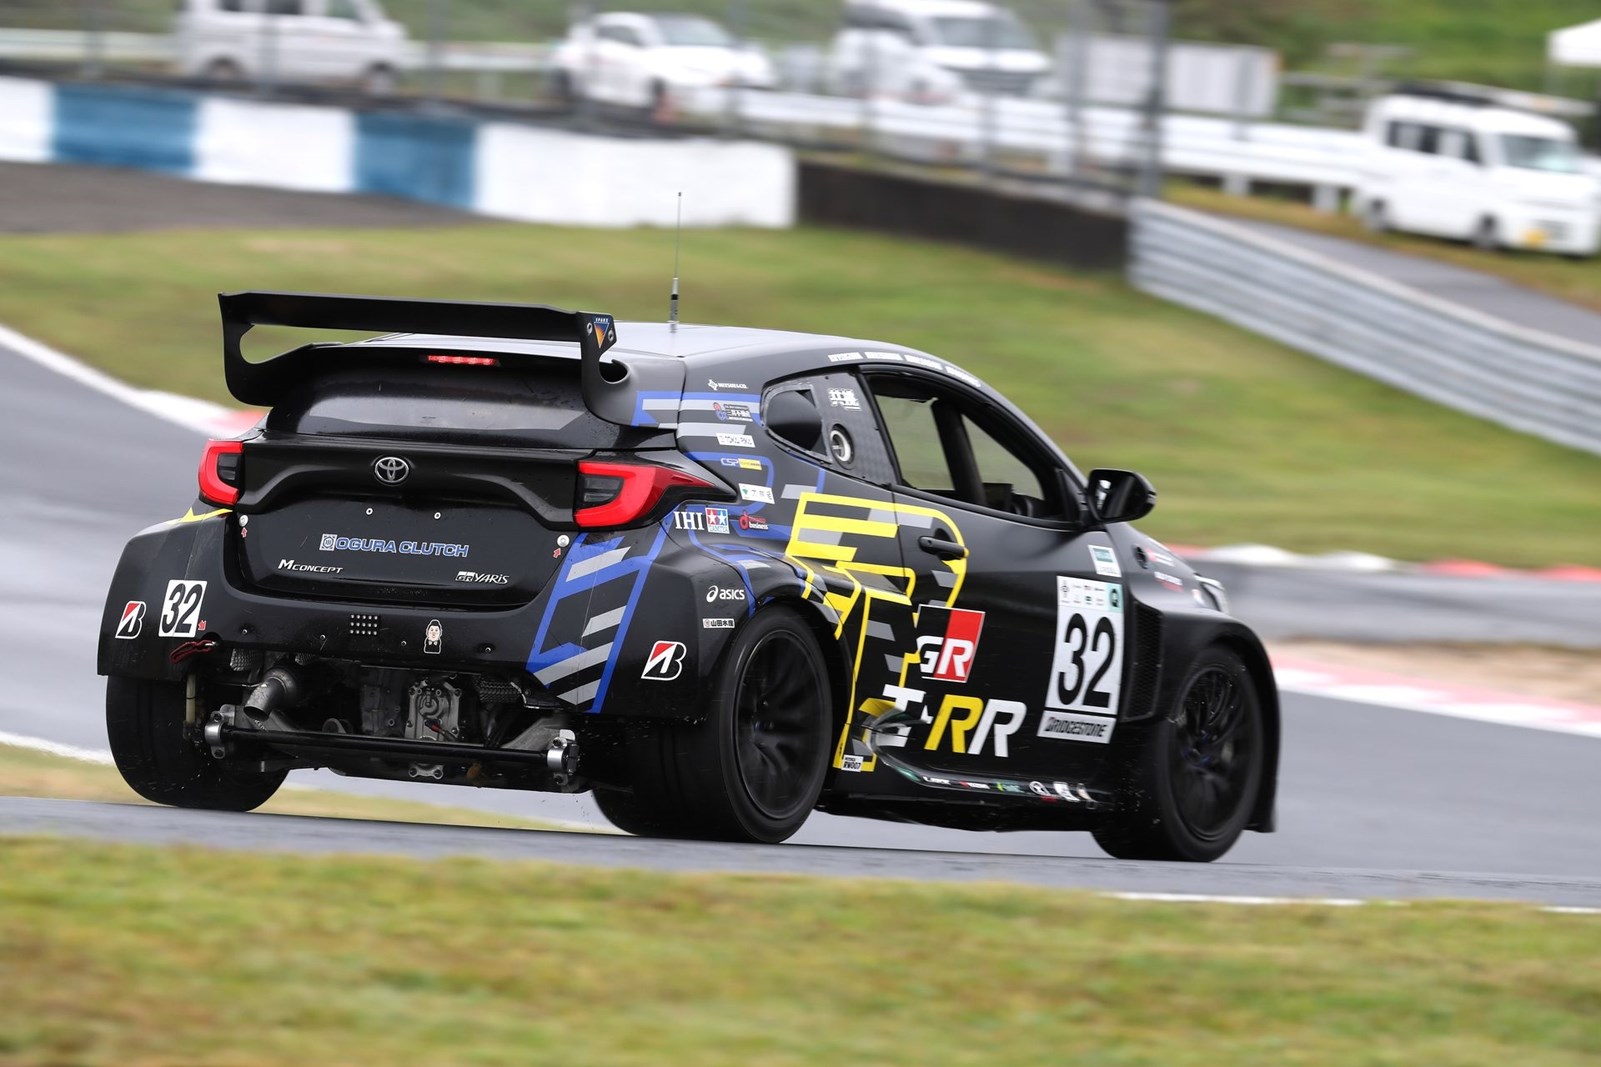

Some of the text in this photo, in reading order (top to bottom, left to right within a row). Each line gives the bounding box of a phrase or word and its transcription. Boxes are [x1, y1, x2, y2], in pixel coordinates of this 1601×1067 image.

[673, 511, 705, 531] IHI
[335, 536, 470, 558] OGURA CLUTCH
[161, 583, 204, 633] 32
[719, 588, 746, 600] asics
[916, 635, 974, 678] GR
[1057, 613, 1116, 709] 32
